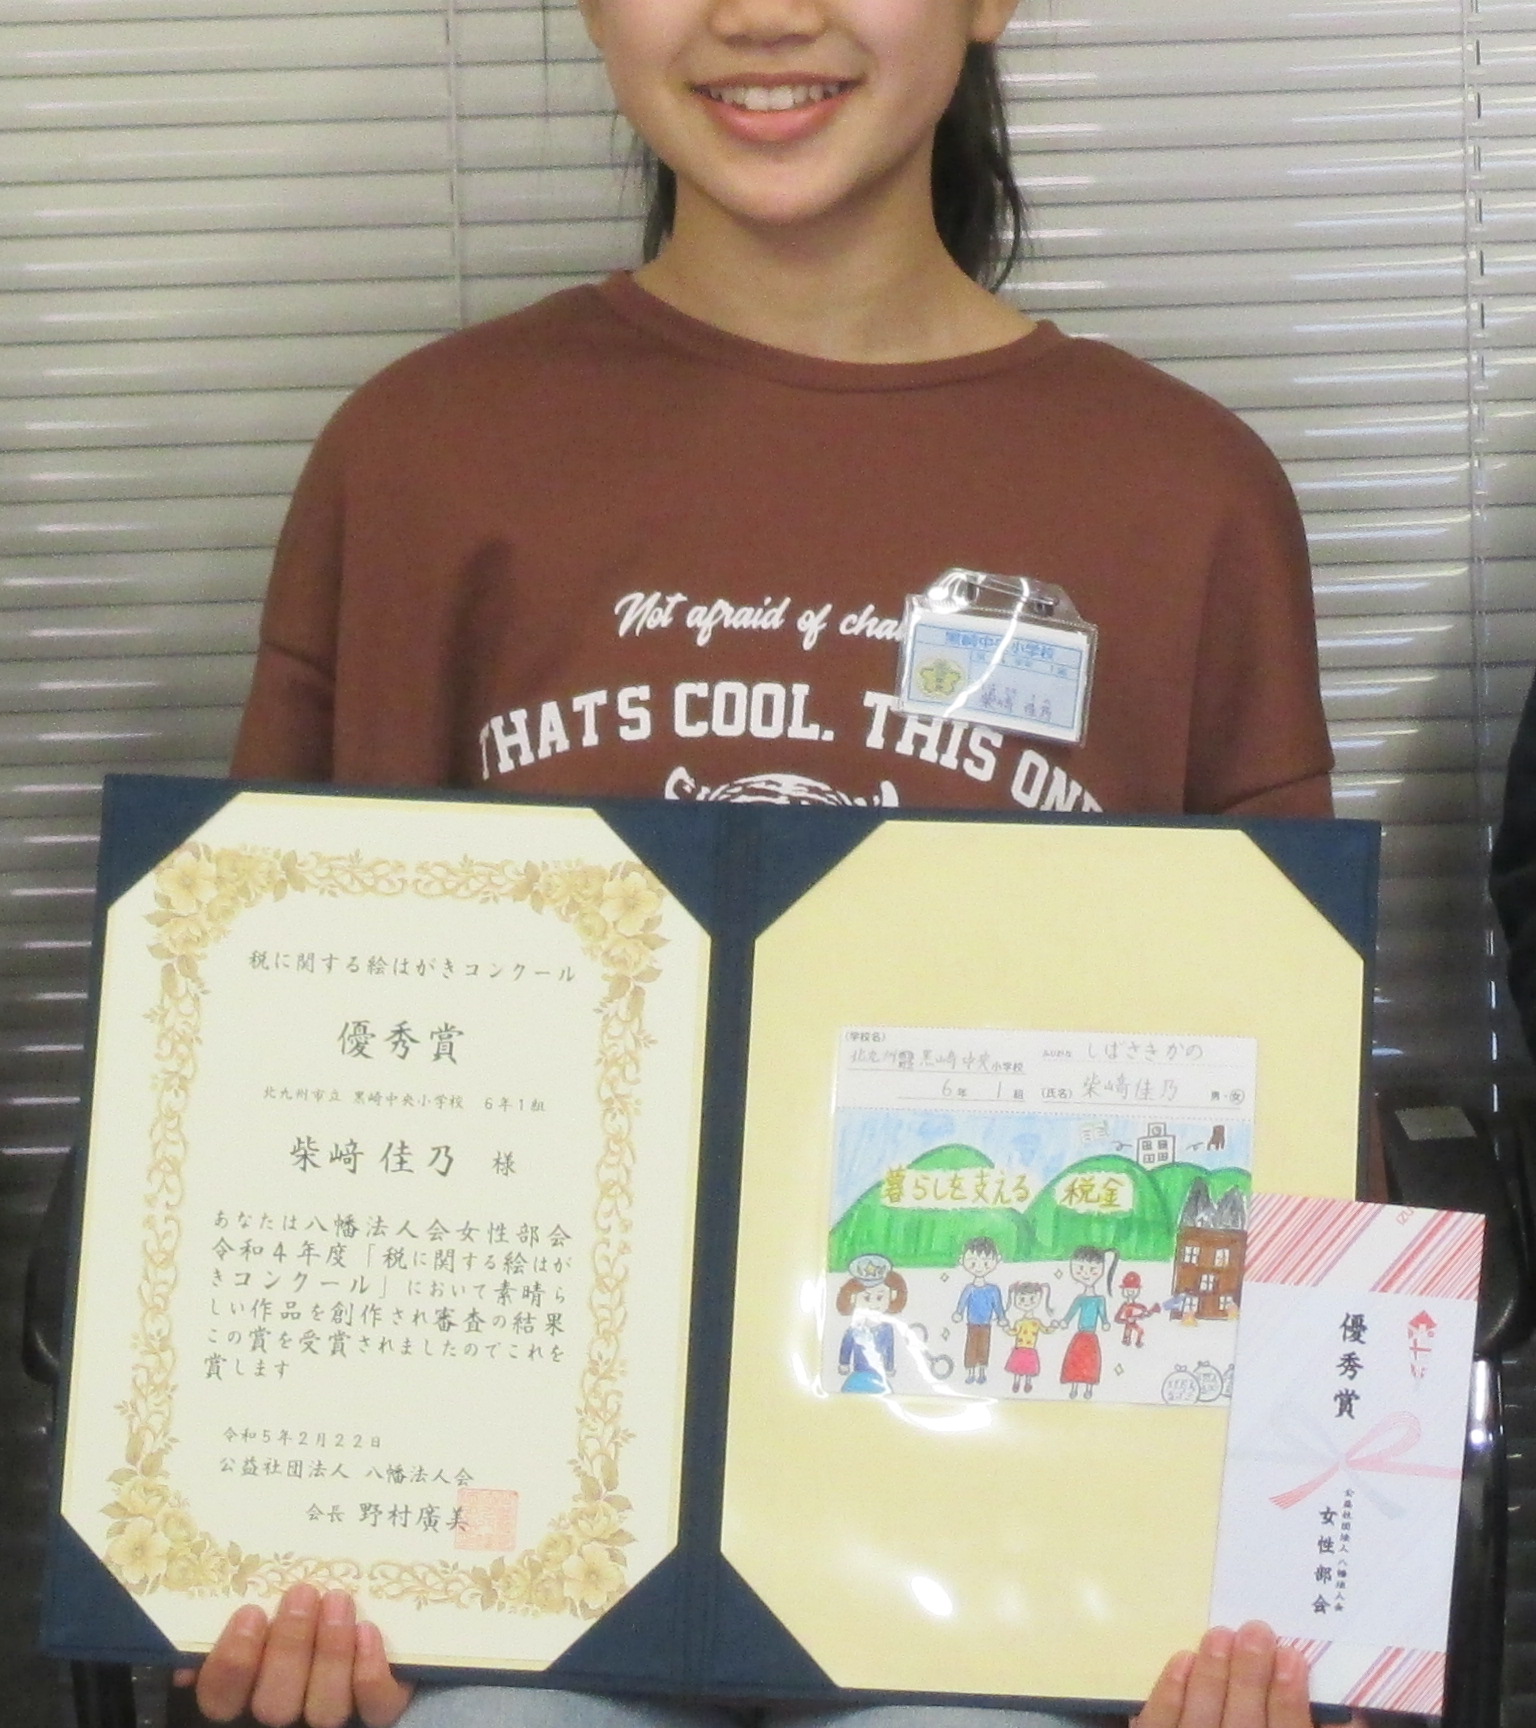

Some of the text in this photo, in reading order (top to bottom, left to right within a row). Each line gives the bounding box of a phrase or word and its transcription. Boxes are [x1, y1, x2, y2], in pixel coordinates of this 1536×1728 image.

[614, 591, 905, 651] Not afraid of cha
[673, 680, 835, 742] COOL.
[863, 690, 1003, 782] THIS
[248, 950, 576, 984] 税に関する絵はがきコンクール
[337, 1020, 465, 1065] 優秀賞
[263, 1085, 342, 1103] 北九州市立
[492, 1149, 517, 1177] 様
[881, 1166, 1127, 1209] 暮らしを支える 税金
[214, 1209, 573, 1248] あなたは八幡法人会女性部会
[209, 1298, 566, 1336] しい作品を創作され審査の結果
[207, 1325, 565, 1364] この賞を受賞されましたのでこれを
[203, 1354, 288, 1382] 賞します
[1333, 1311, 1369, 1421] 優秀賞
[222, 1425, 383, 1449] 令和5年2月22日
[218, 1455, 475, 1487] 公益社団法人 八幡法人会
[306, 1503, 343, 1523] 会長
[1311, 1504, 1338, 1615] 女性部会
